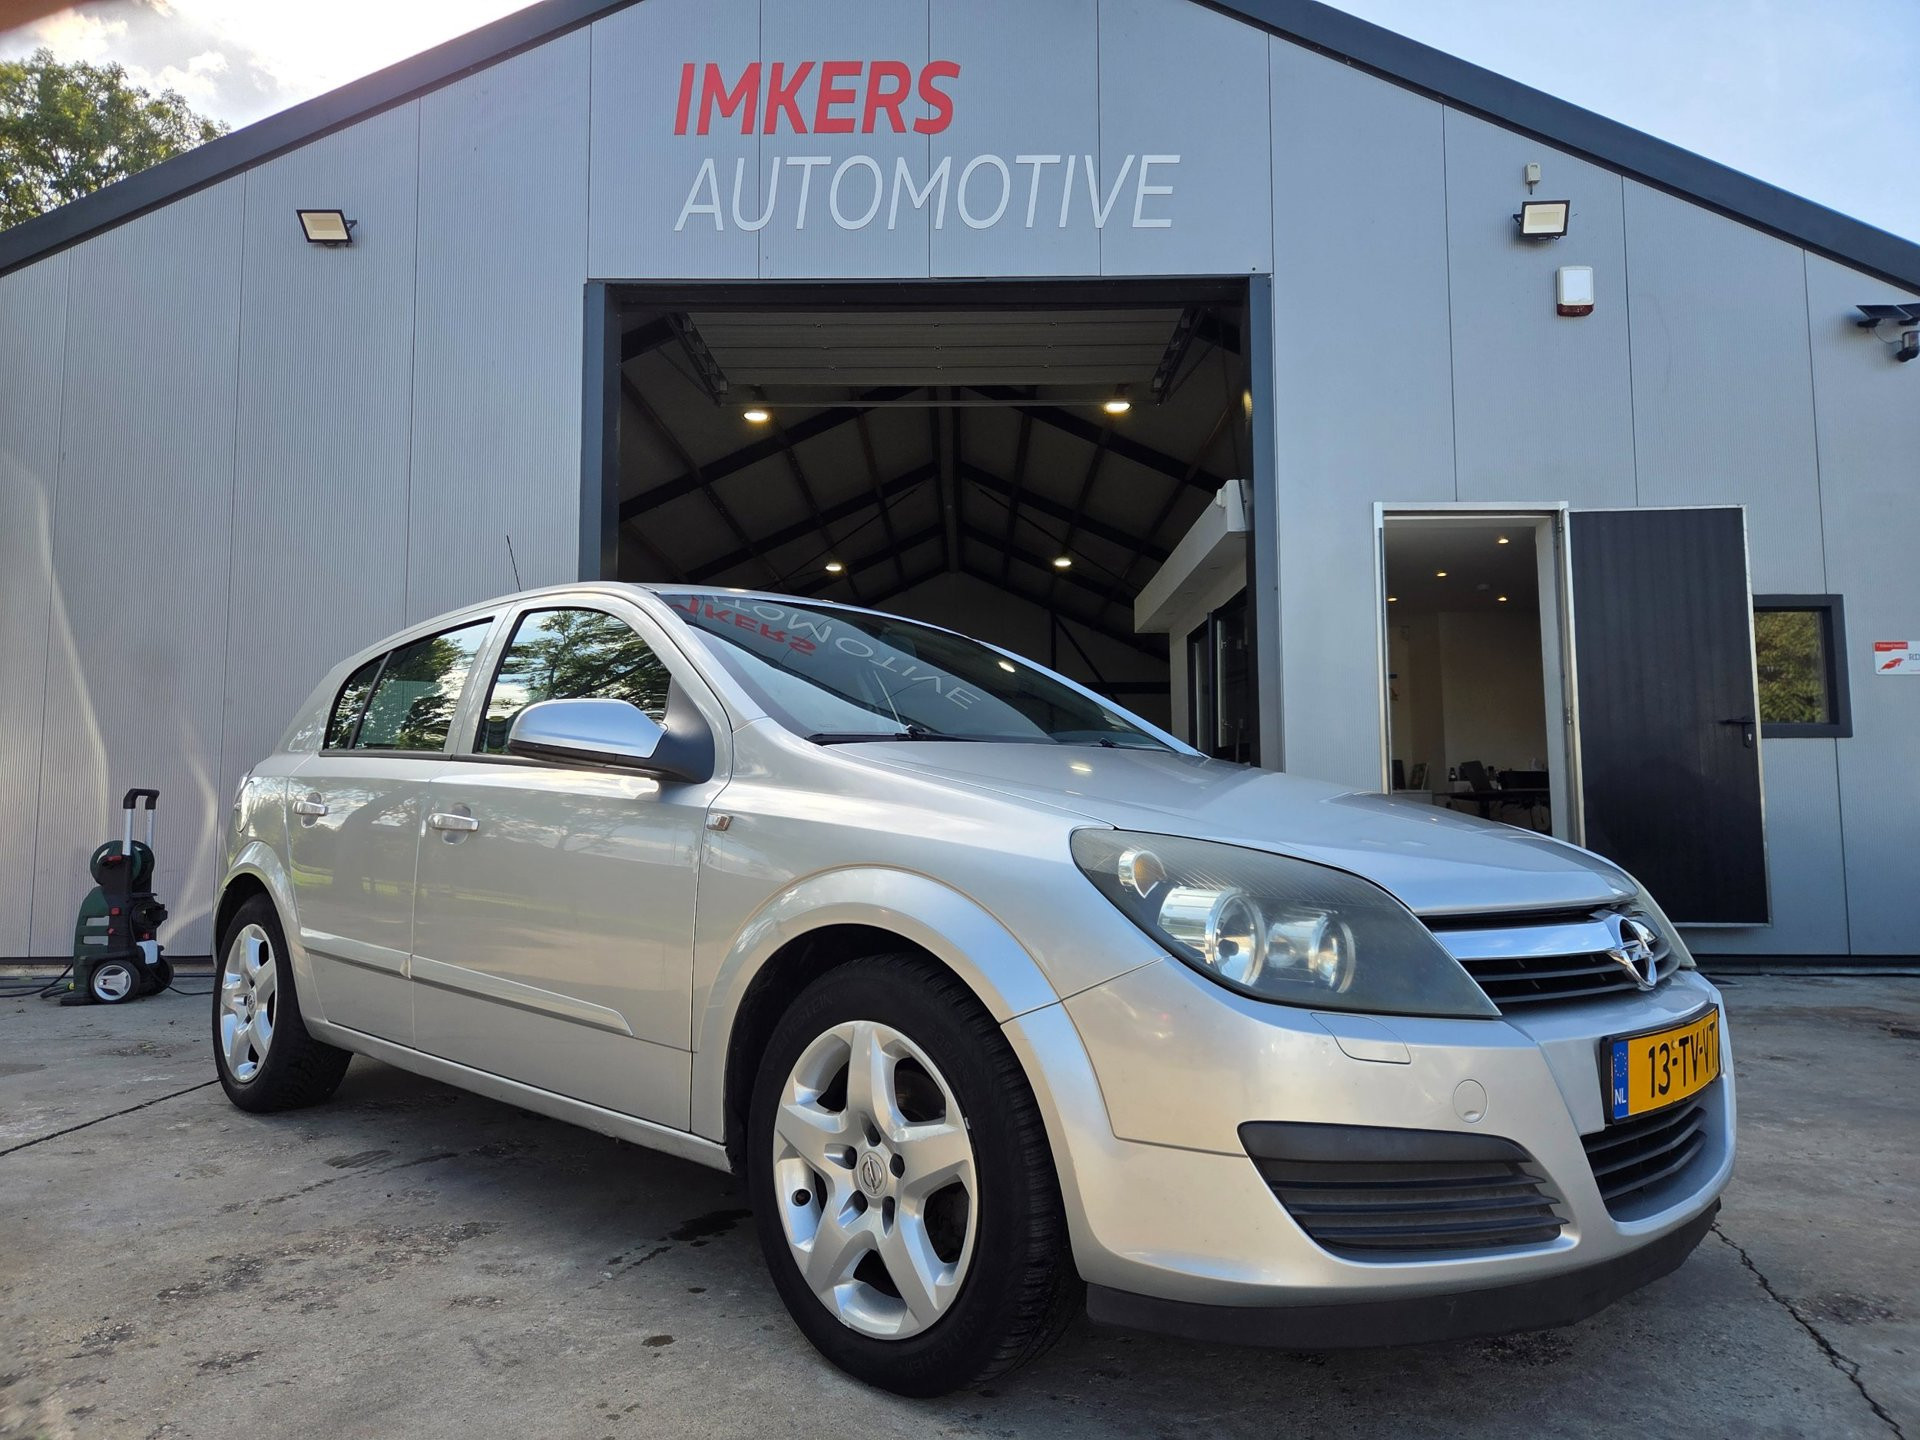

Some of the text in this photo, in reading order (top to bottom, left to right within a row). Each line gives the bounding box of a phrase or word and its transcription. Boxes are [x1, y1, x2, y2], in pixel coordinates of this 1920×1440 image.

[674, 60, 961, 136] IMKERS
[674, 154, 1181, 231] AUTOMOTIVE
[1614, 1022, 1716, 1105] NL 13-TV-VT
